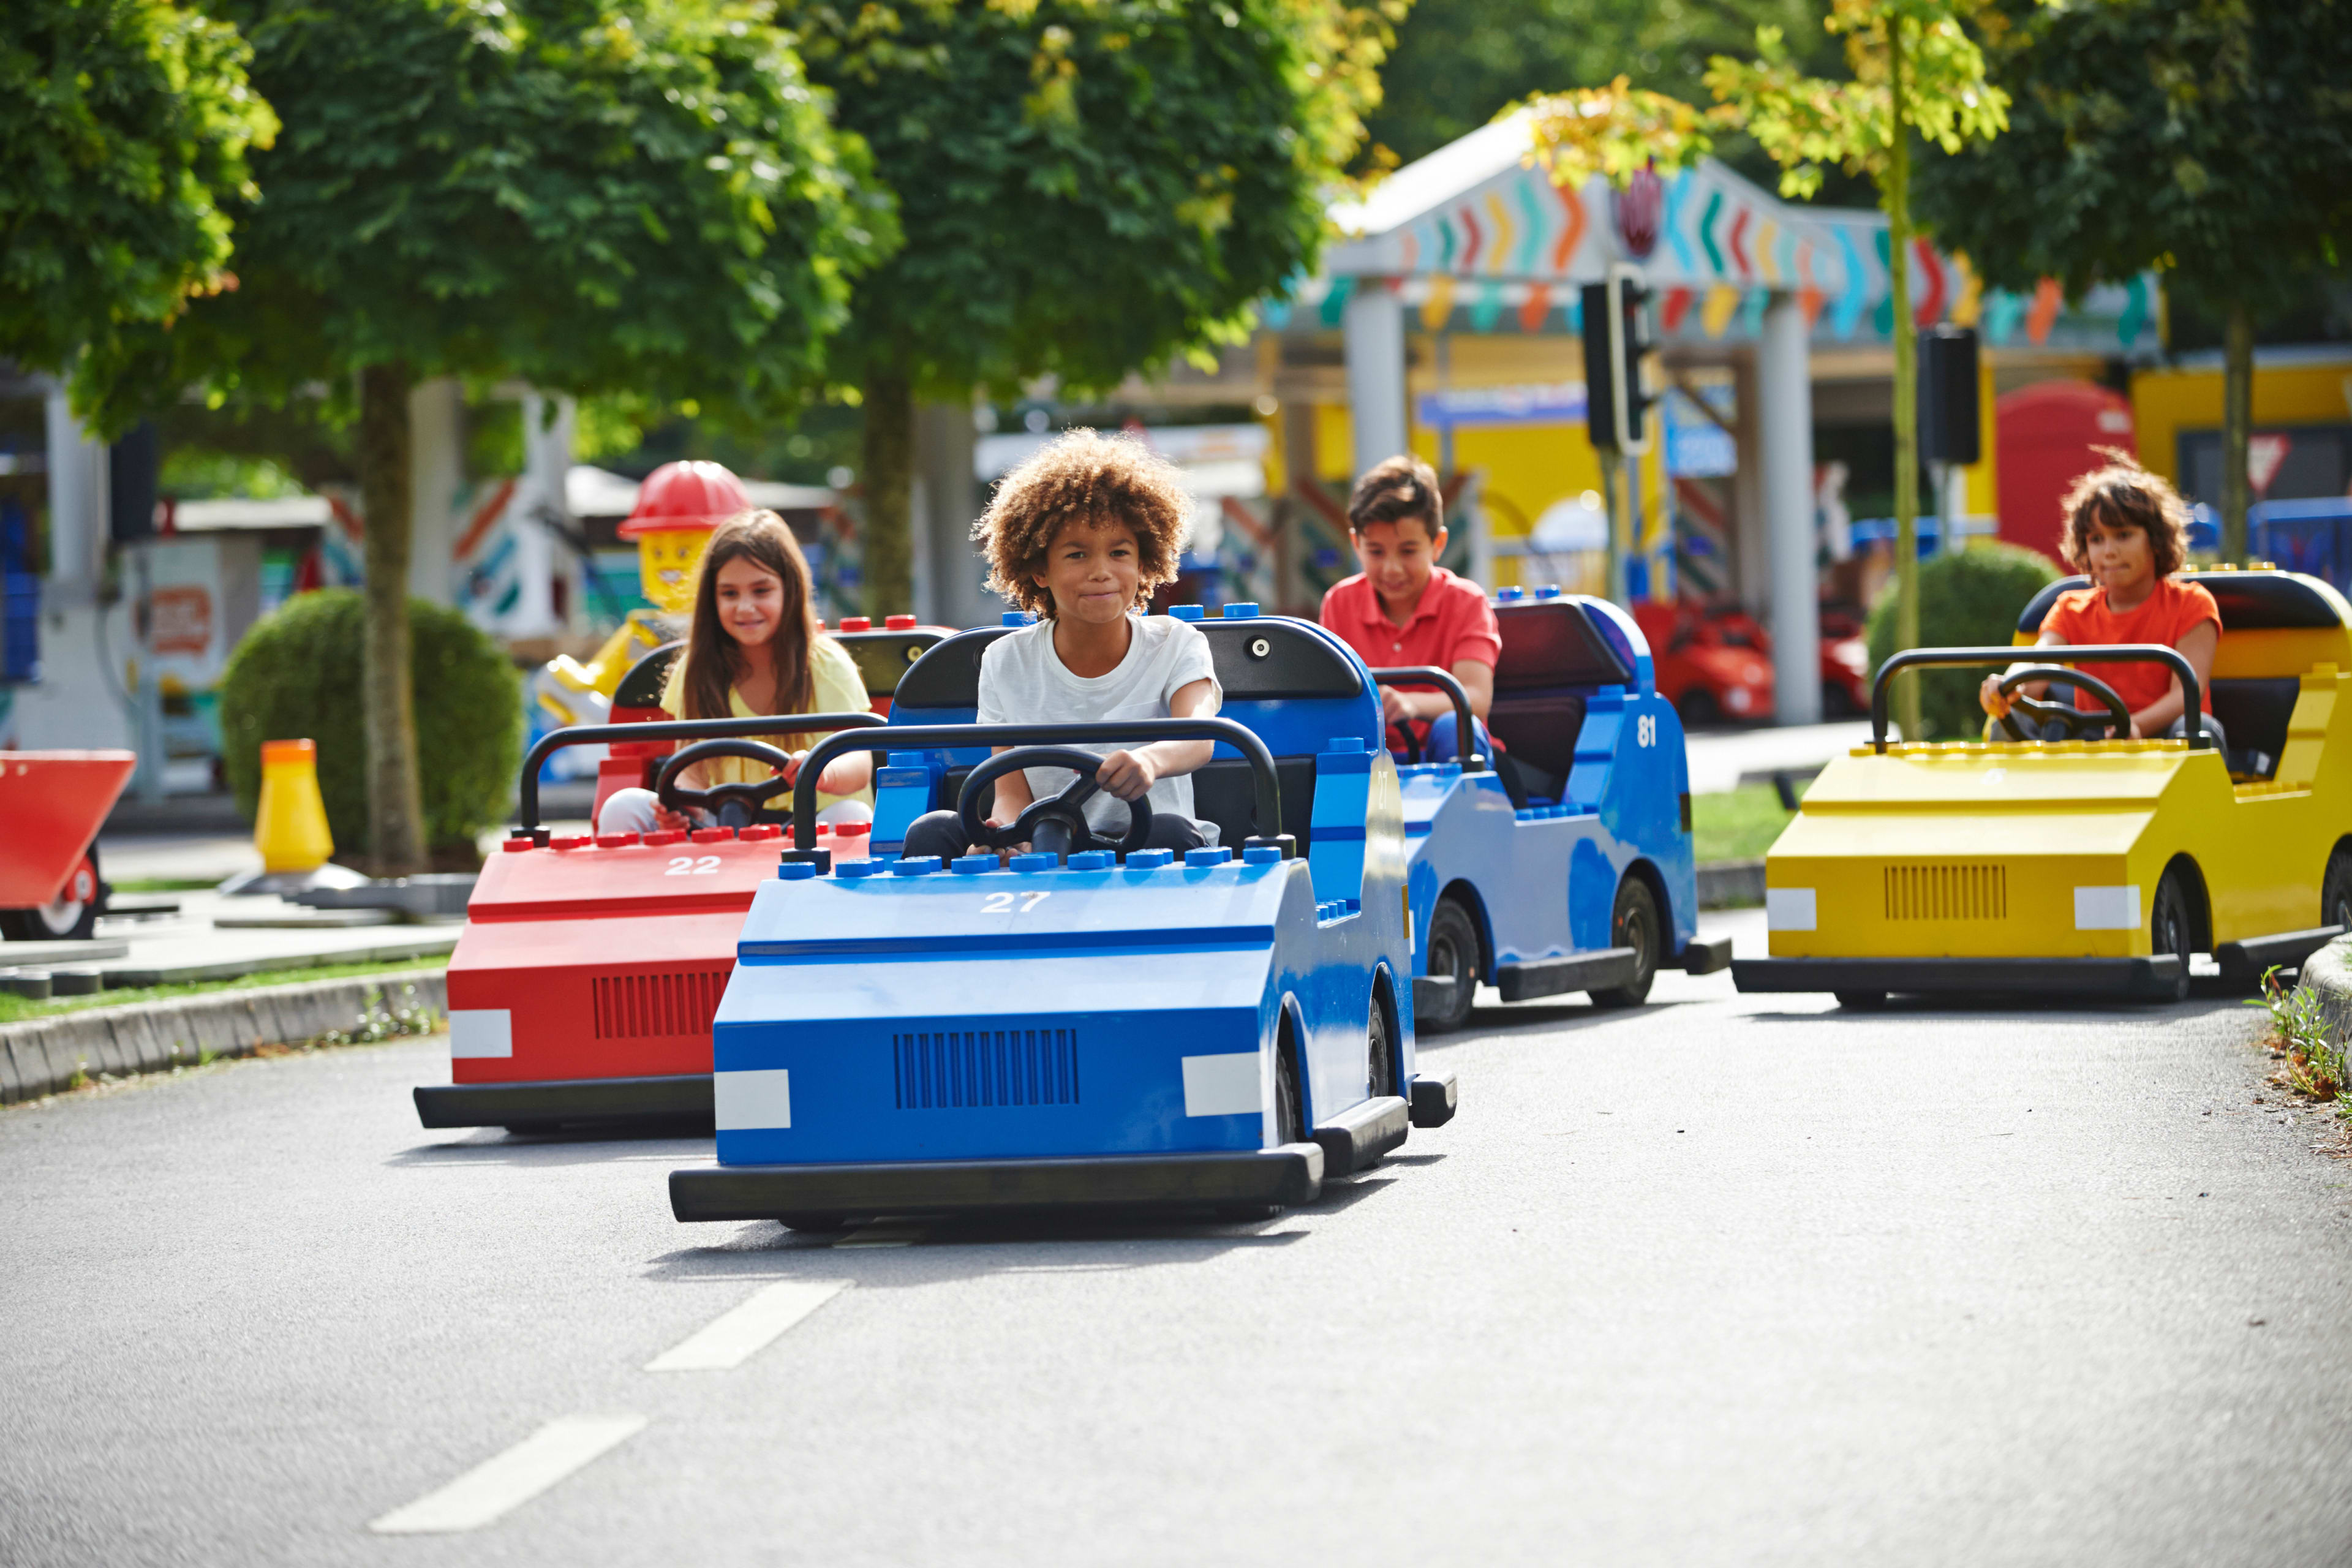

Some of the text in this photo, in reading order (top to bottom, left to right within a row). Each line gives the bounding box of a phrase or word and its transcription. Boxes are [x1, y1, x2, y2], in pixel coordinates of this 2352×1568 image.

[1637, 714, 1656, 748] 81
[665, 855, 722, 875] 22
[980, 891, 1051, 913] 27
